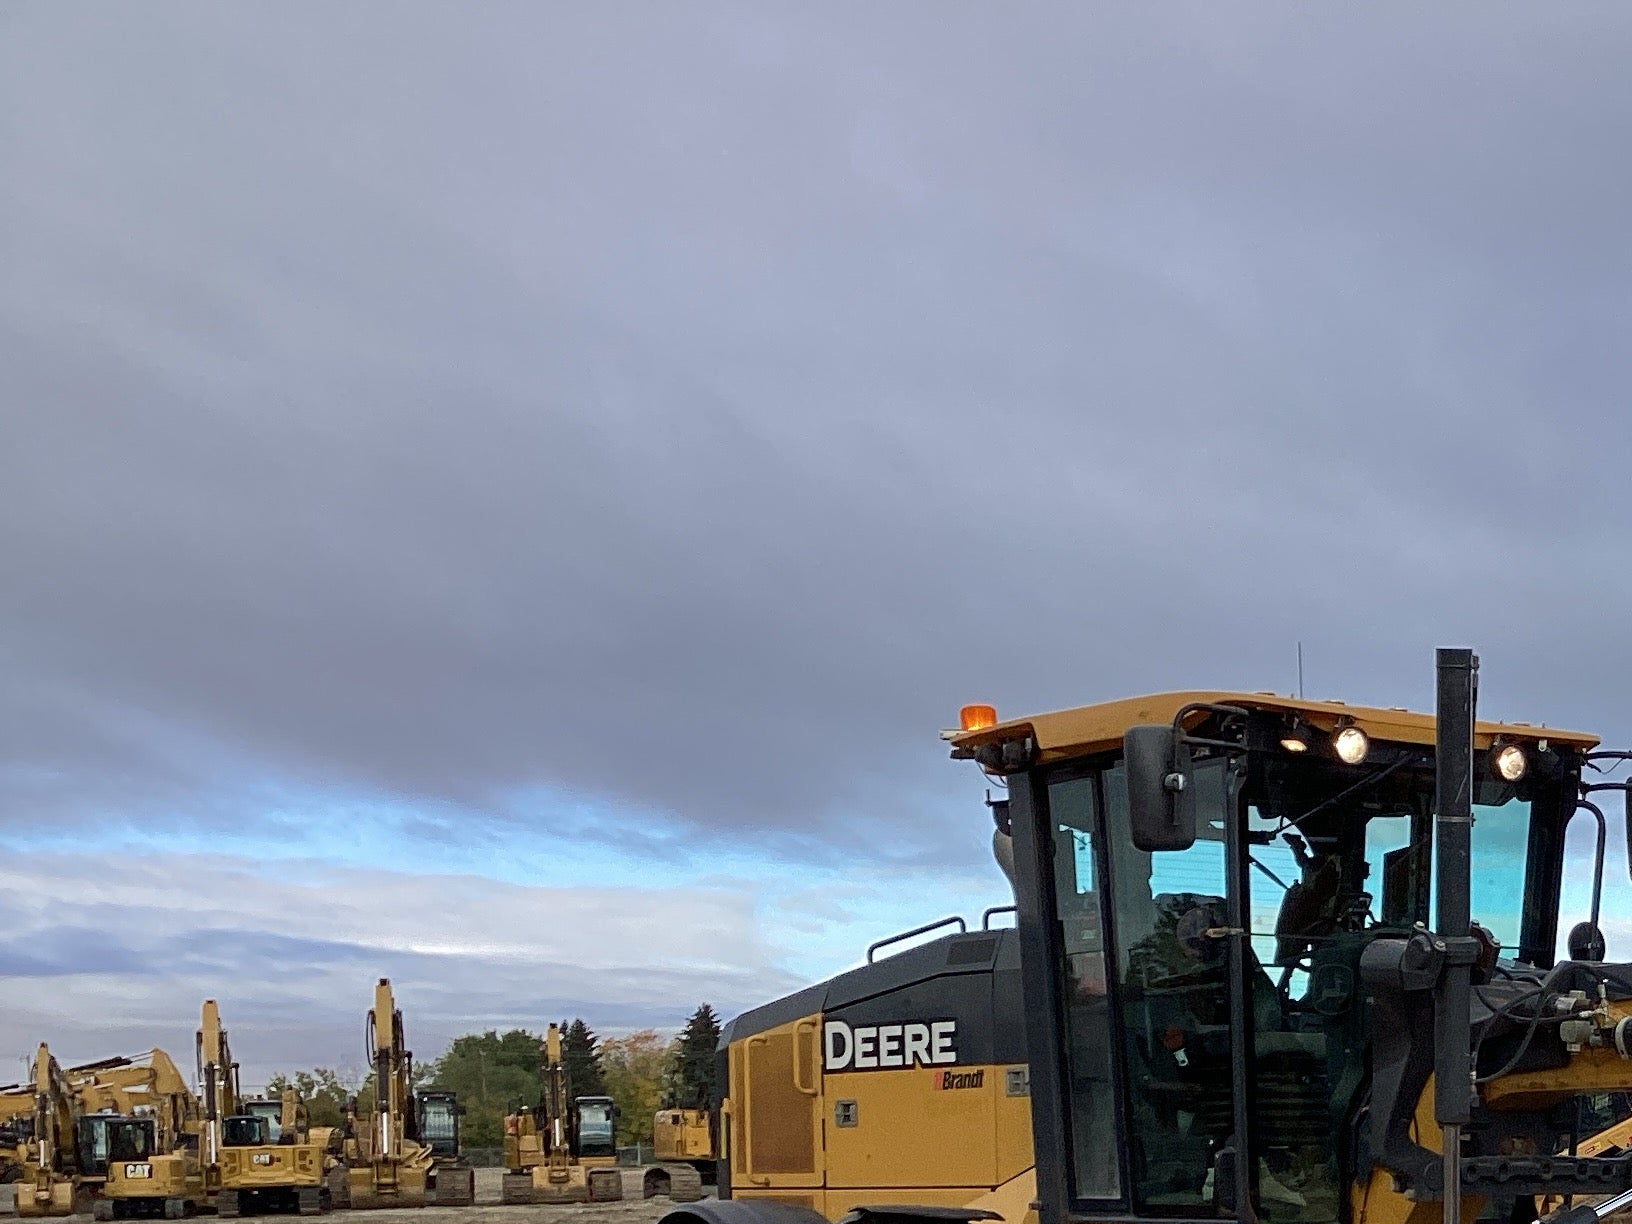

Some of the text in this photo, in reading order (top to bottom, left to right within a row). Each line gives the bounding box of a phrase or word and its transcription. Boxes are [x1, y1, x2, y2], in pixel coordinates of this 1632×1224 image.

[825, 1021, 957, 1070] DEERE
[942, 1069, 984, 1090] Brandt
[252, 1153, 270, 1165] CAT
[126, 1164, 150, 1179] CAT
